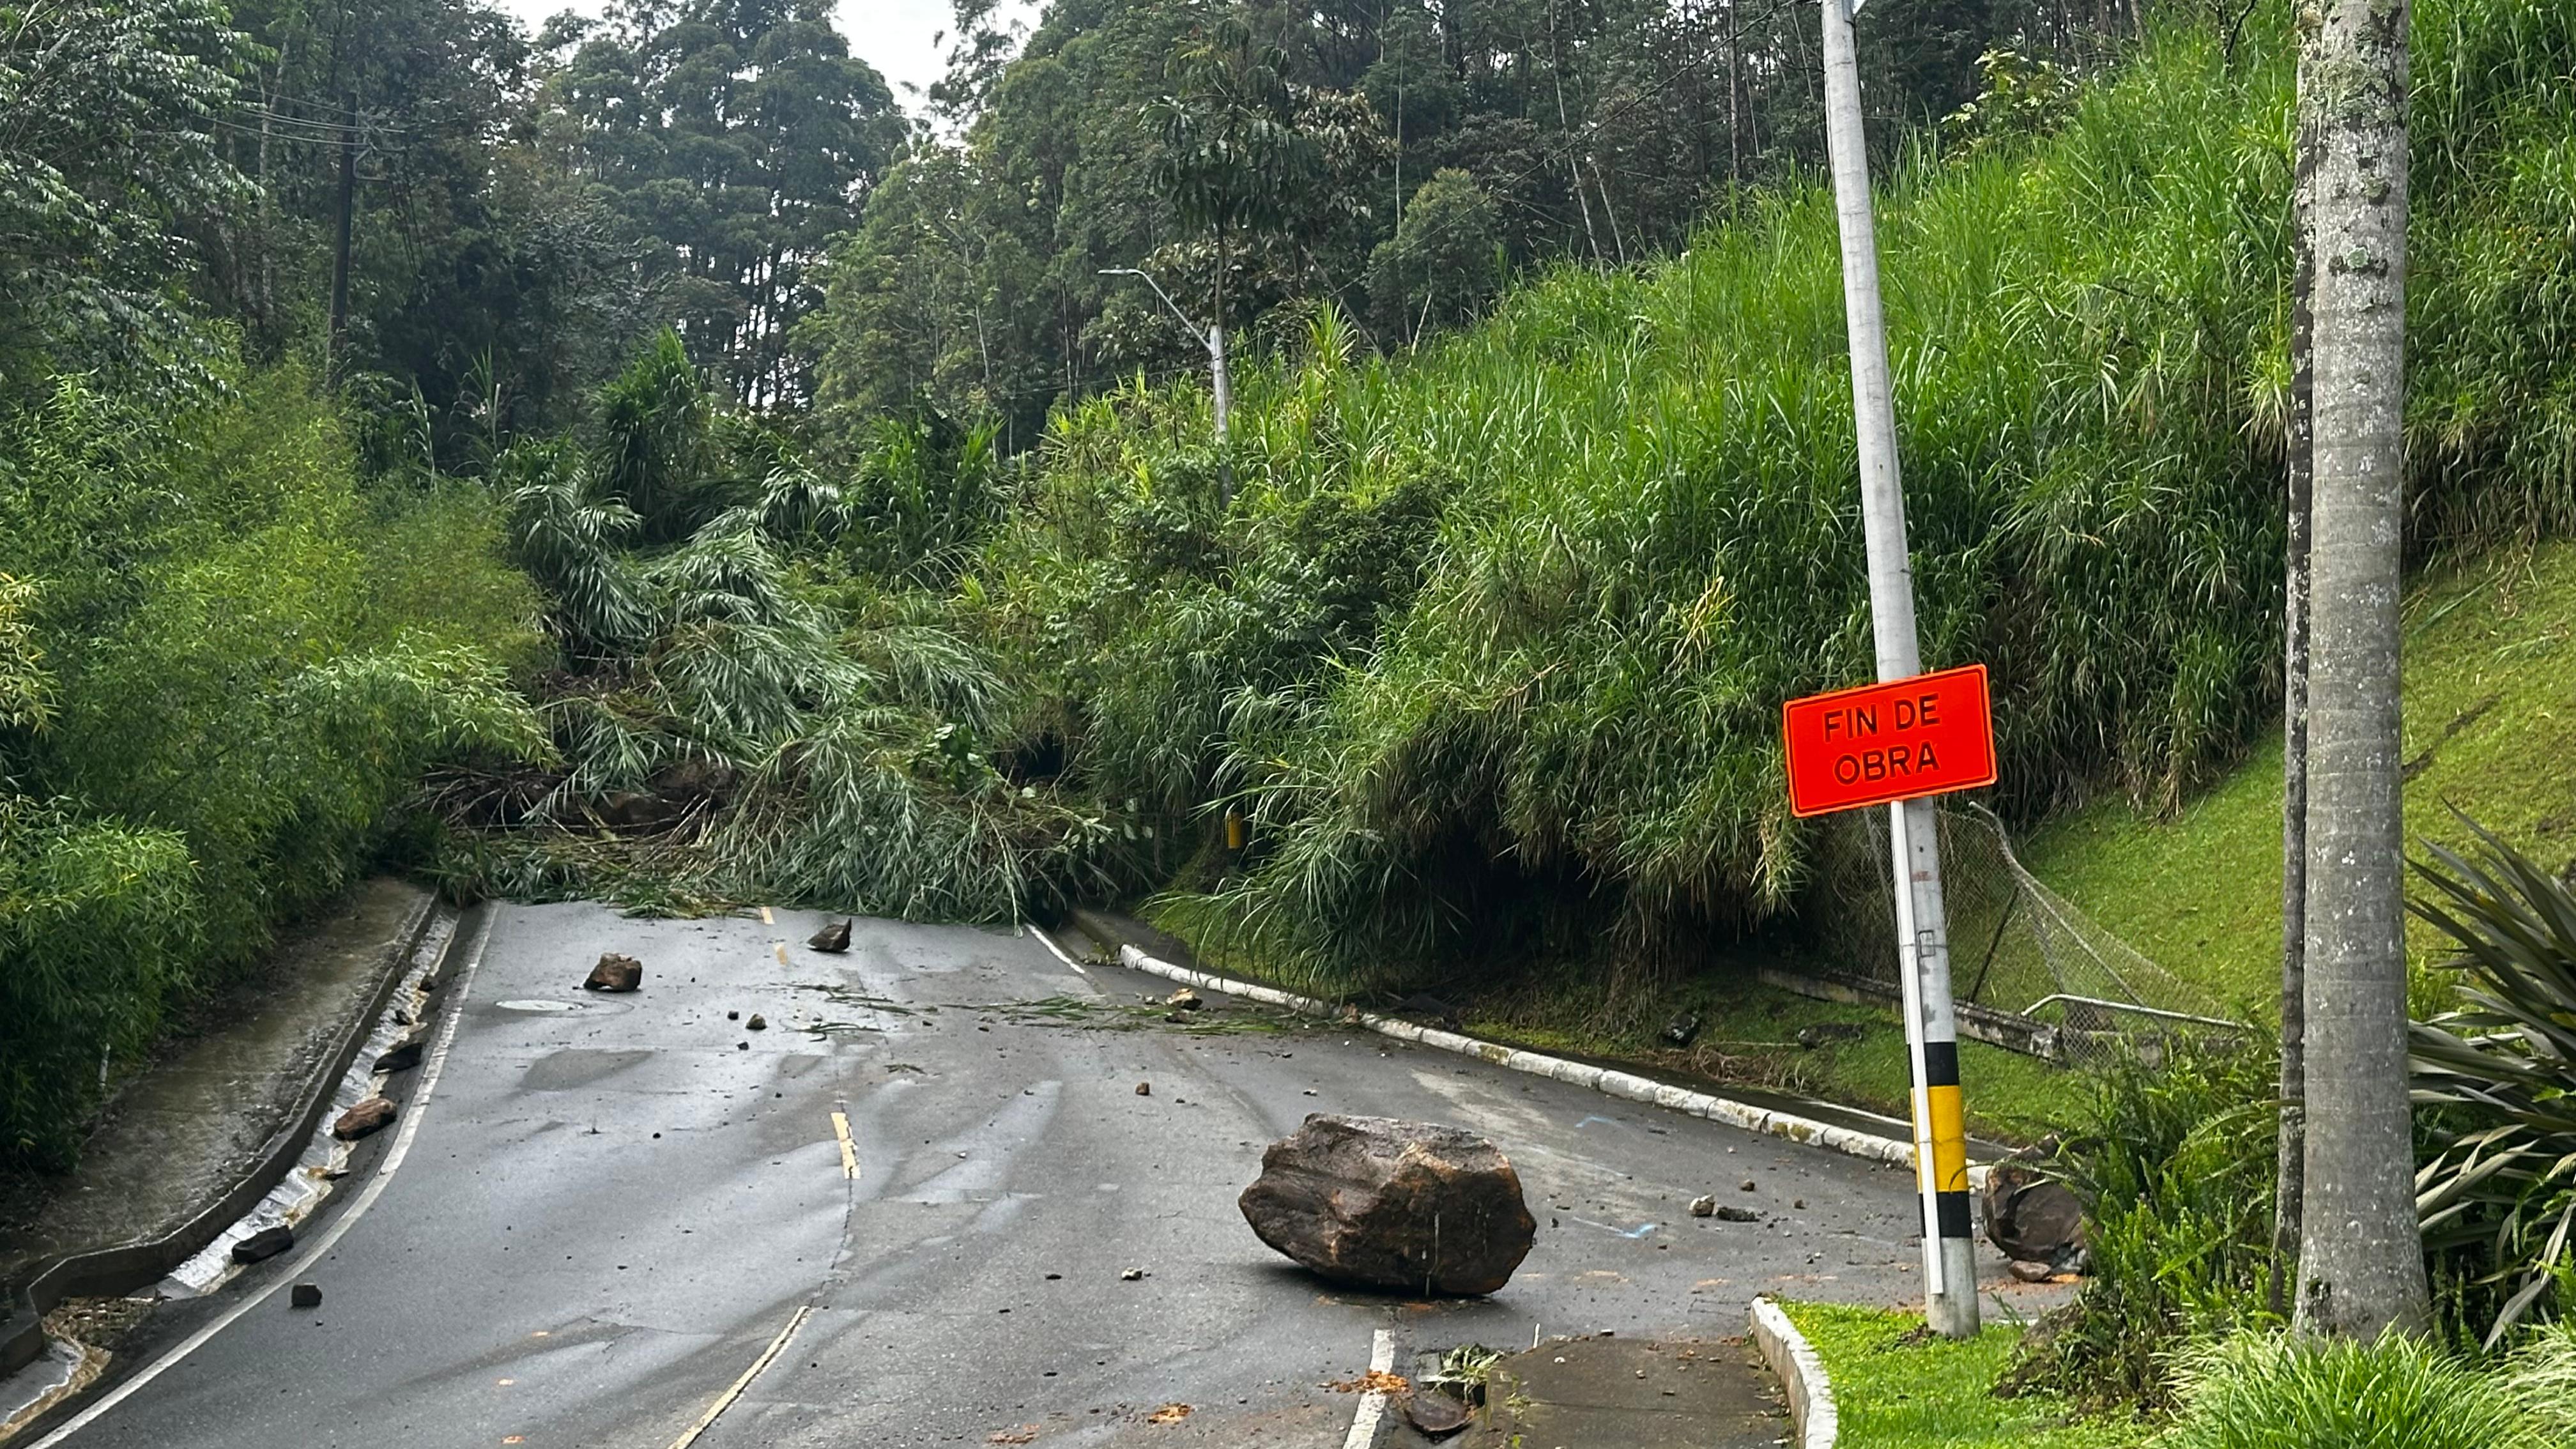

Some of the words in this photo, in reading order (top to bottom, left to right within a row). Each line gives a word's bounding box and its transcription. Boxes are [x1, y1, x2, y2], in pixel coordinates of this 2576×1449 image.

[1824, 704, 1878, 742] FIN
[1894, 693, 1940, 731] DE
[1834, 740, 1940, 785] OBRA
